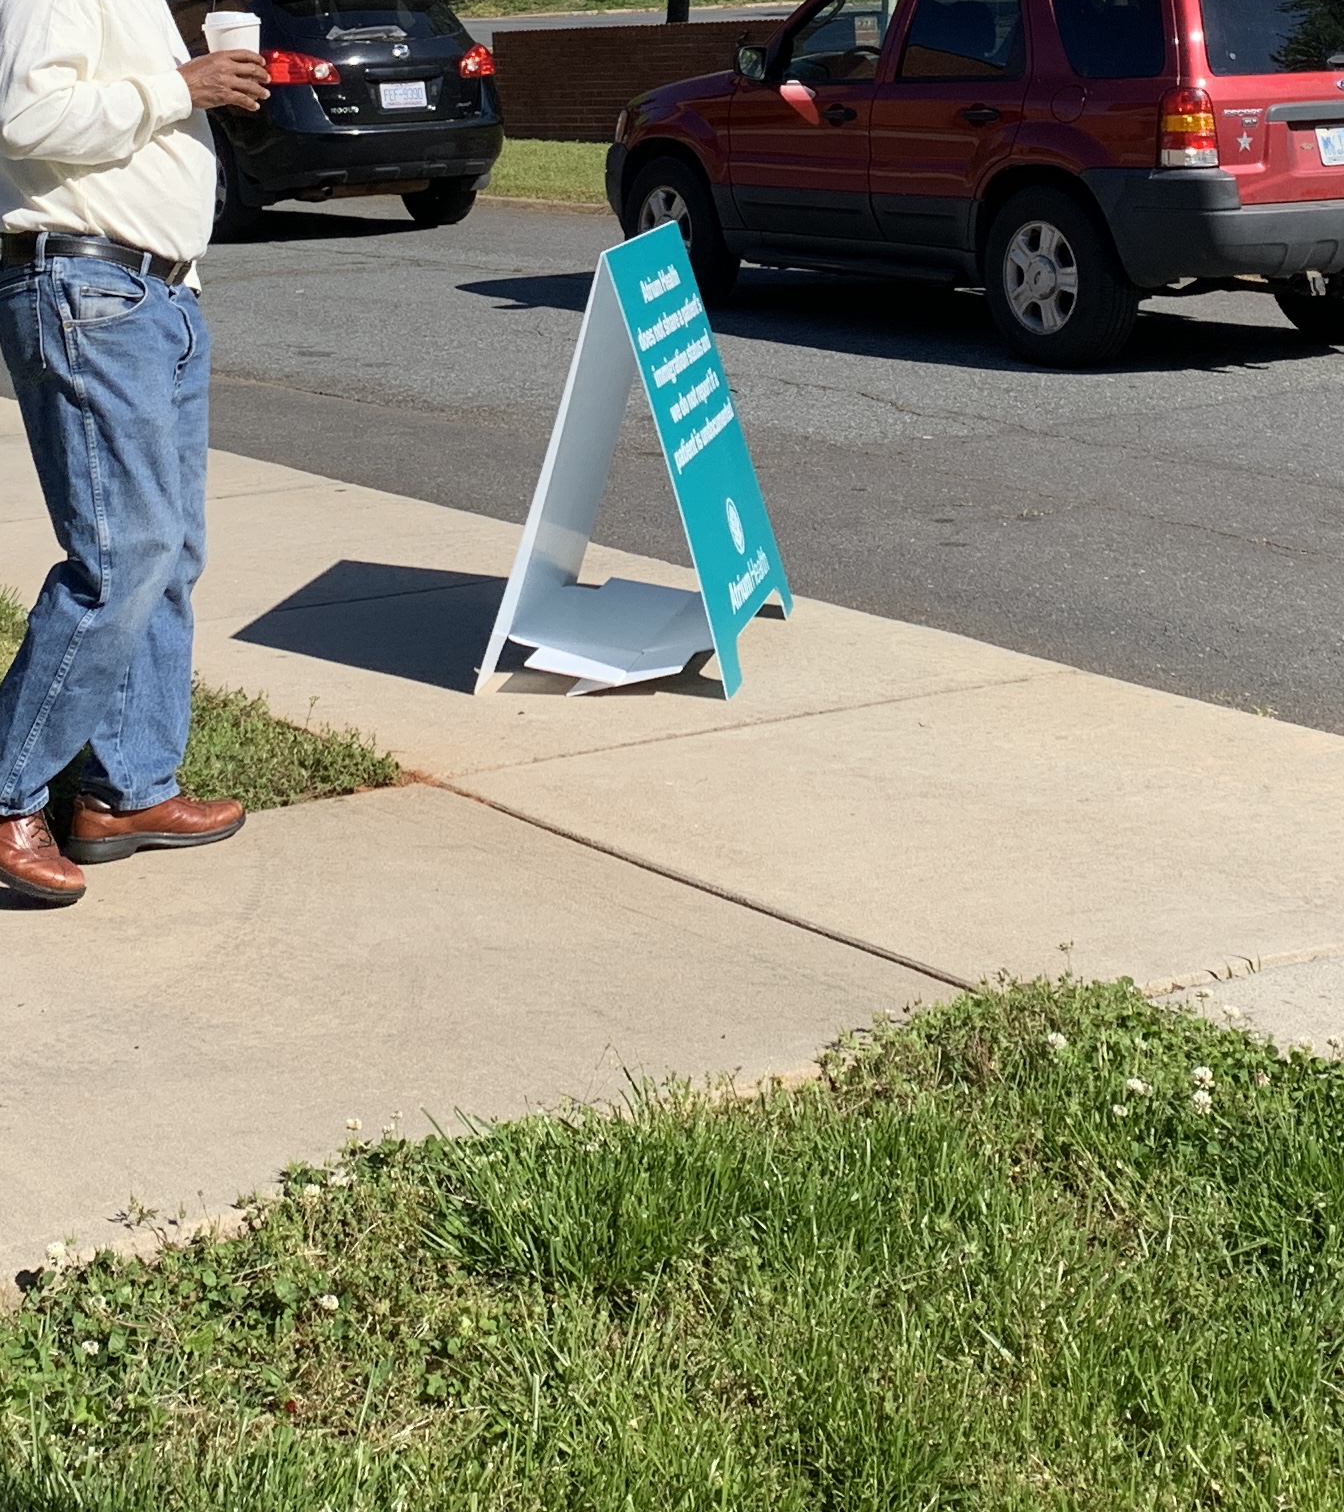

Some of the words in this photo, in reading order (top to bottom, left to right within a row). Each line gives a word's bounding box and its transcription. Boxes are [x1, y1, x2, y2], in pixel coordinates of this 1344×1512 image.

[640, 276, 665, 304] Atrium
[658, 264, 681, 292] Health
[638, 327, 657, 352] does
[653, 317, 667, 342] not
[662, 312, 681, 336] share
[651, 348, 690, 388] immigration
[685, 339, 704, 364] status
[700, 328, 711, 353] and
[669, 403, 683, 423] we
[678, 392, 690, 416] do
[686, 385, 700, 411] not
[696, 373, 712, 404] report
[673, 432, 699, 476] patient
[692, 428, 704, 452] is
[699, 396, 735, 446] undocumented
